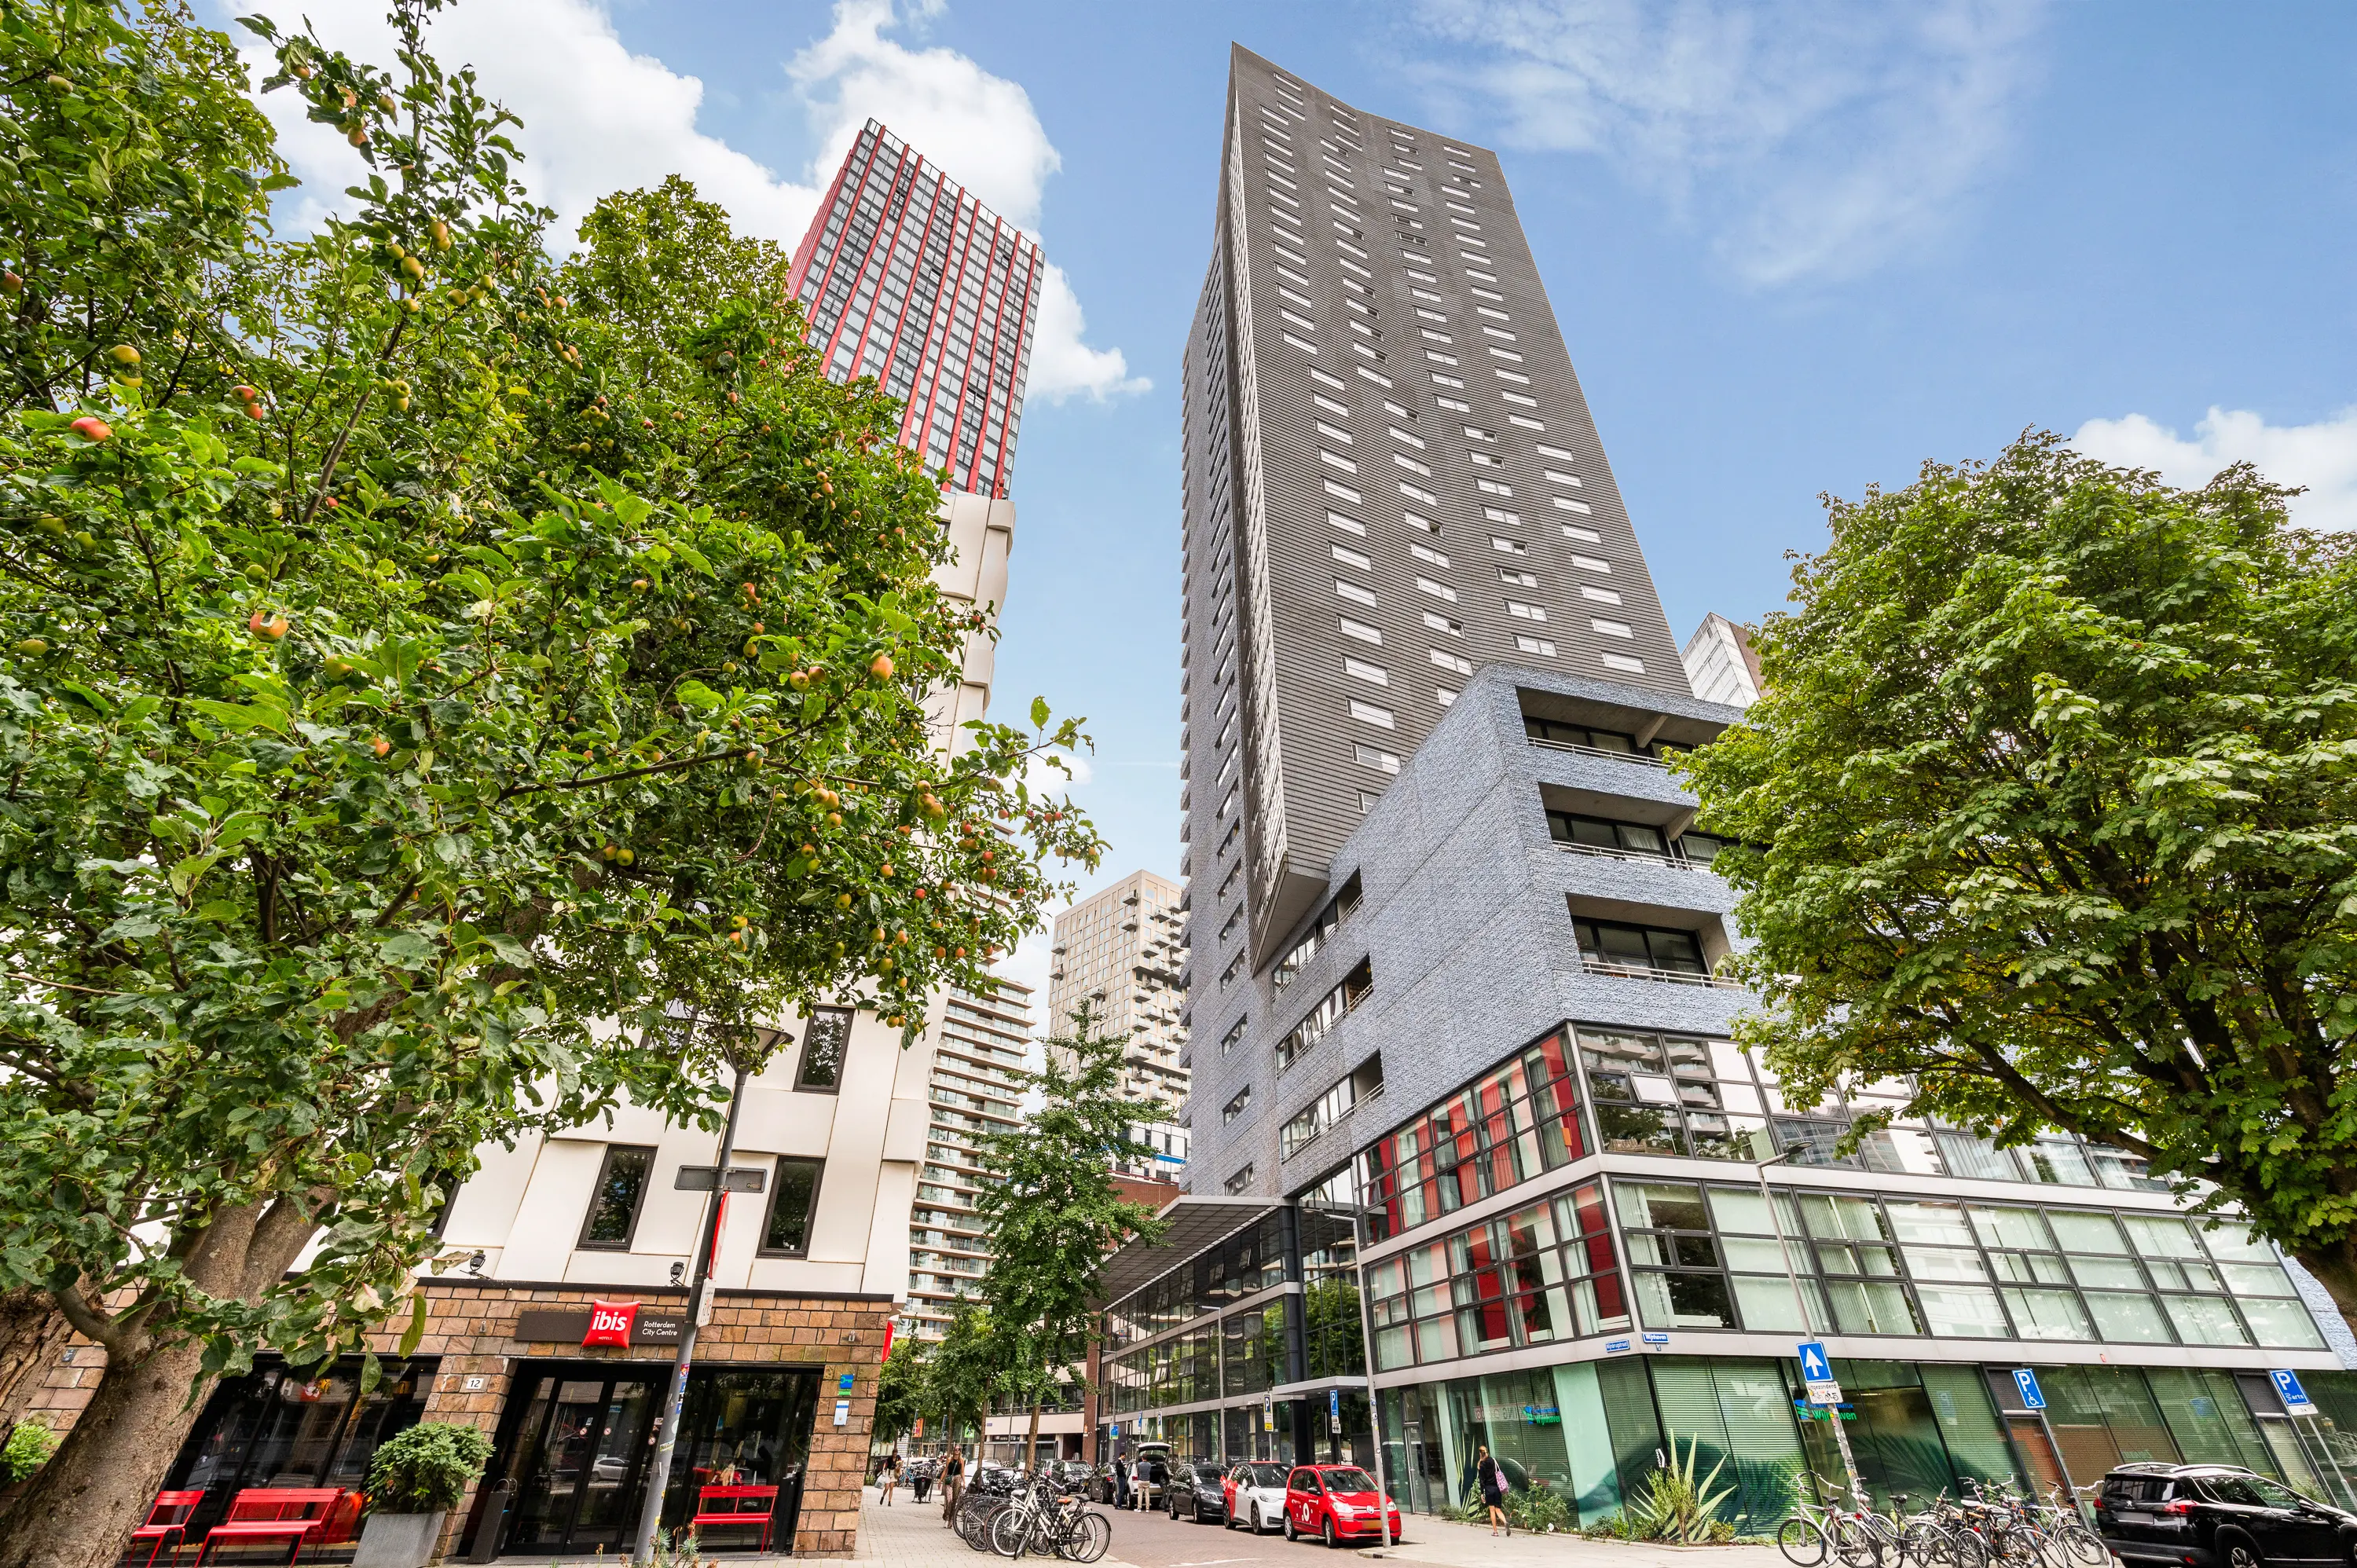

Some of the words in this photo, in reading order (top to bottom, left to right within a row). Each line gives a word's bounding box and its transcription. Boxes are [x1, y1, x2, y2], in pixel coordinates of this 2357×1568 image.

[592, 1311, 627, 1331] ibis
[2017, 1372, 2031, 1392] P
[2275, 1372, 2291, 1390] P
[1265, 1398, 1270, 1411] P
[1812, 1409, 1857, 1422] Wijnaven
